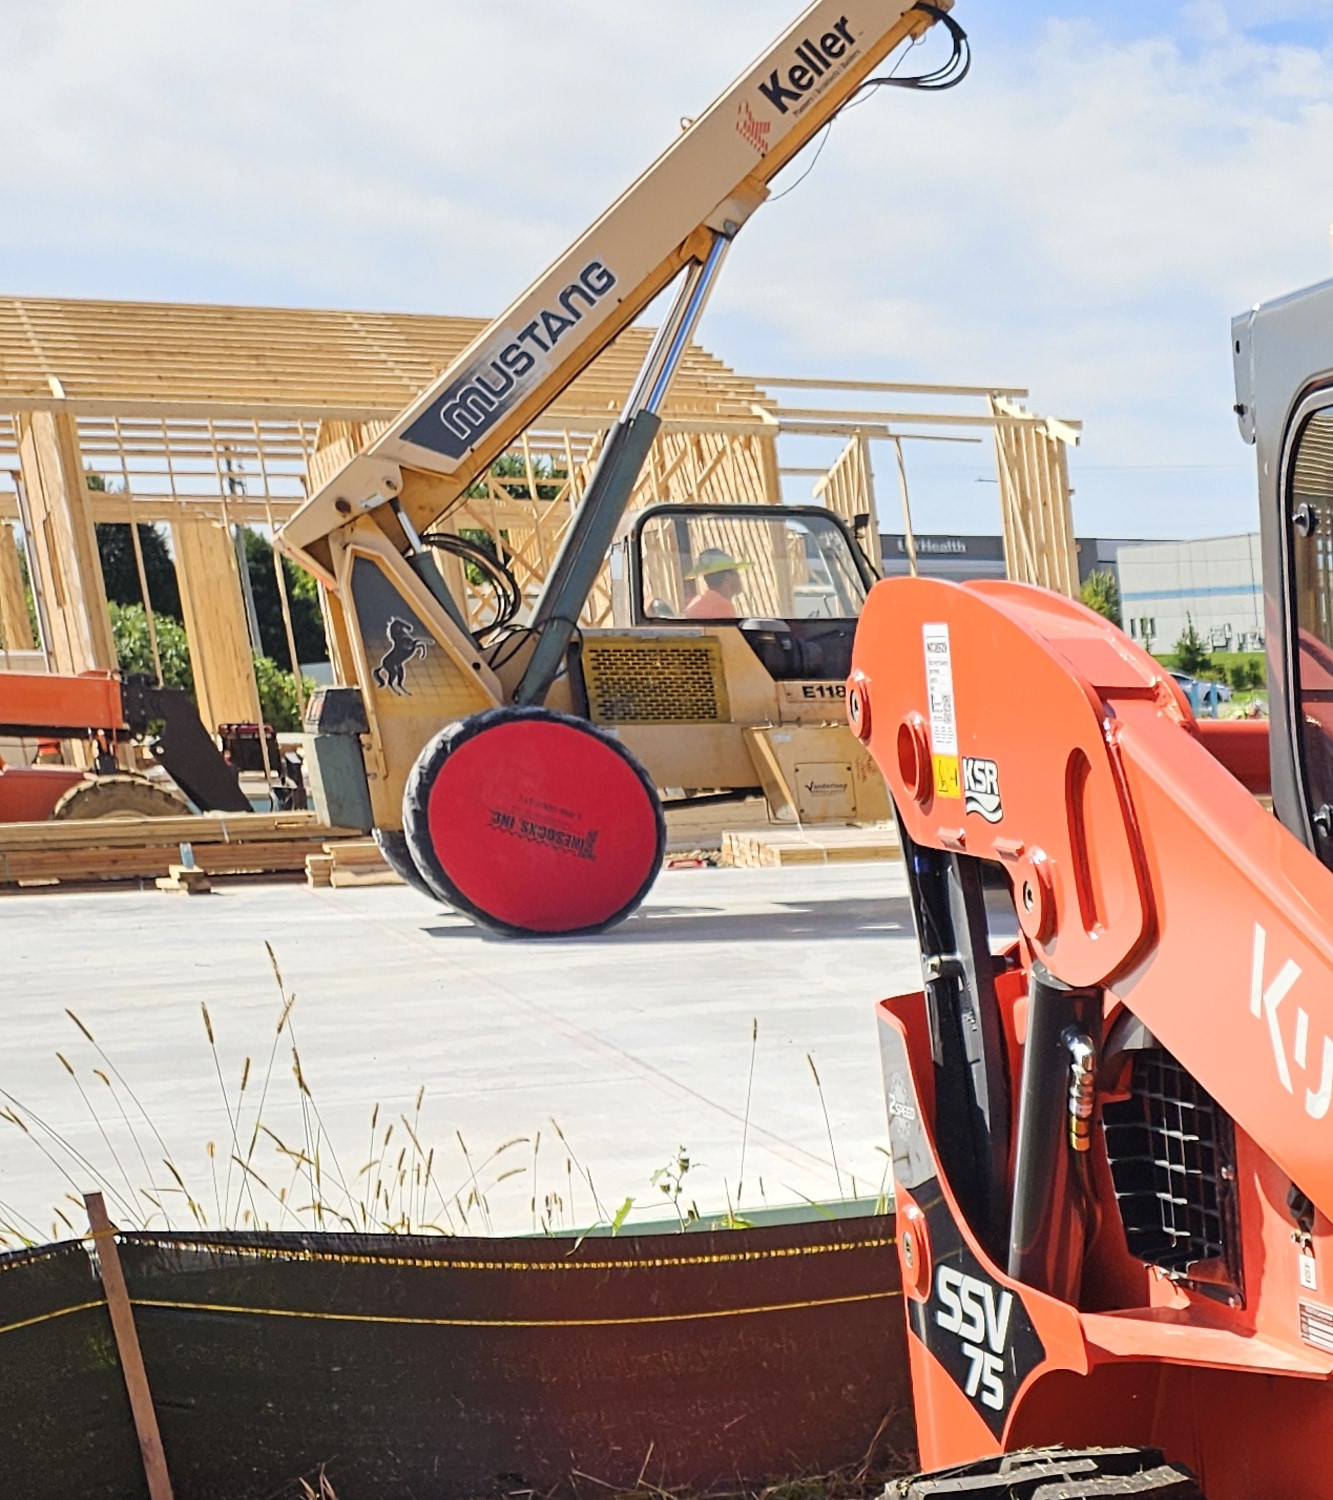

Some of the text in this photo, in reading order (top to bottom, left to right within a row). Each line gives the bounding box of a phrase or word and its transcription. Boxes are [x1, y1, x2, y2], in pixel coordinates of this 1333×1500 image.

[758, 16, 856, 115] Keller
[440, 261, 617, 441] MUSTANG
[962, 756, 999, 796] KSR
[936, 1264, 1014, 1355] SSV
[961, 1342, 1004, 1411] 75
